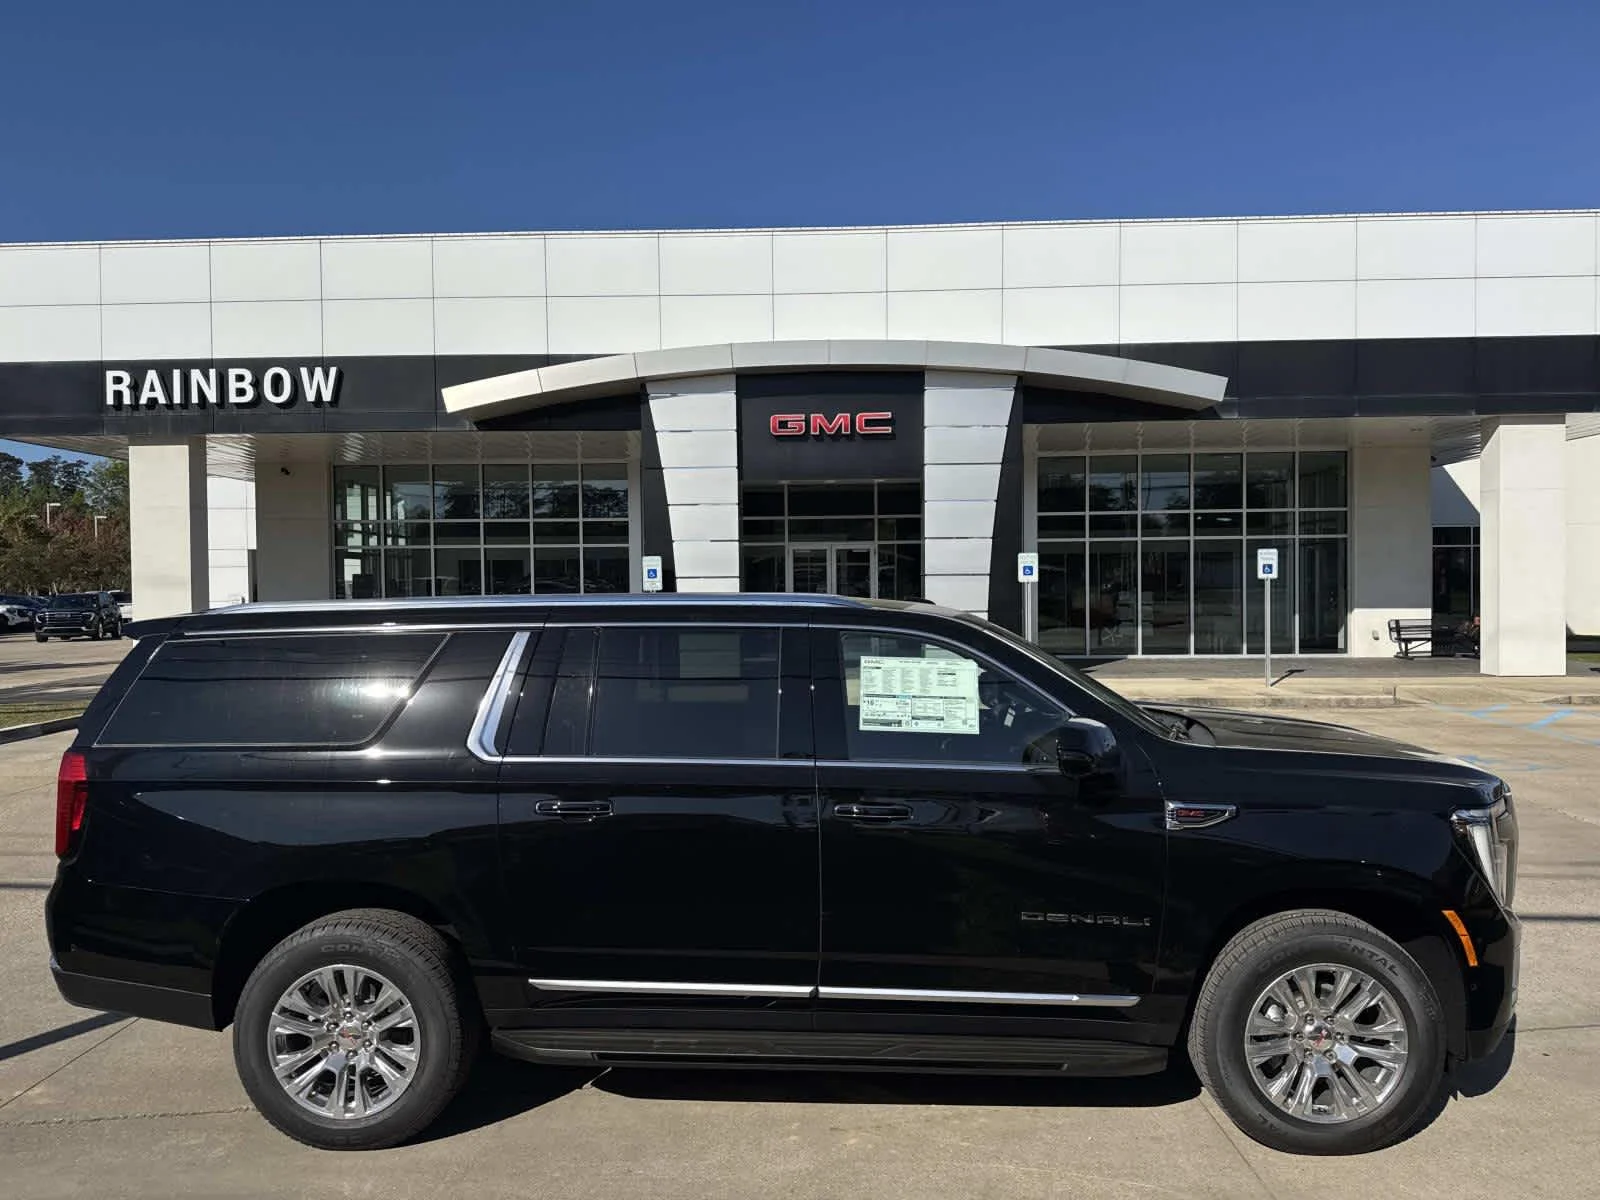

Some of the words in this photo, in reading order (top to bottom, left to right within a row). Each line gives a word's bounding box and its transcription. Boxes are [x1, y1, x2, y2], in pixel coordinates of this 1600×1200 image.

[105, 366, 338, 406] RAINBOW
[769, 411, 893, 436] GMC
[1021, 911, 1151, 927] DENALI
